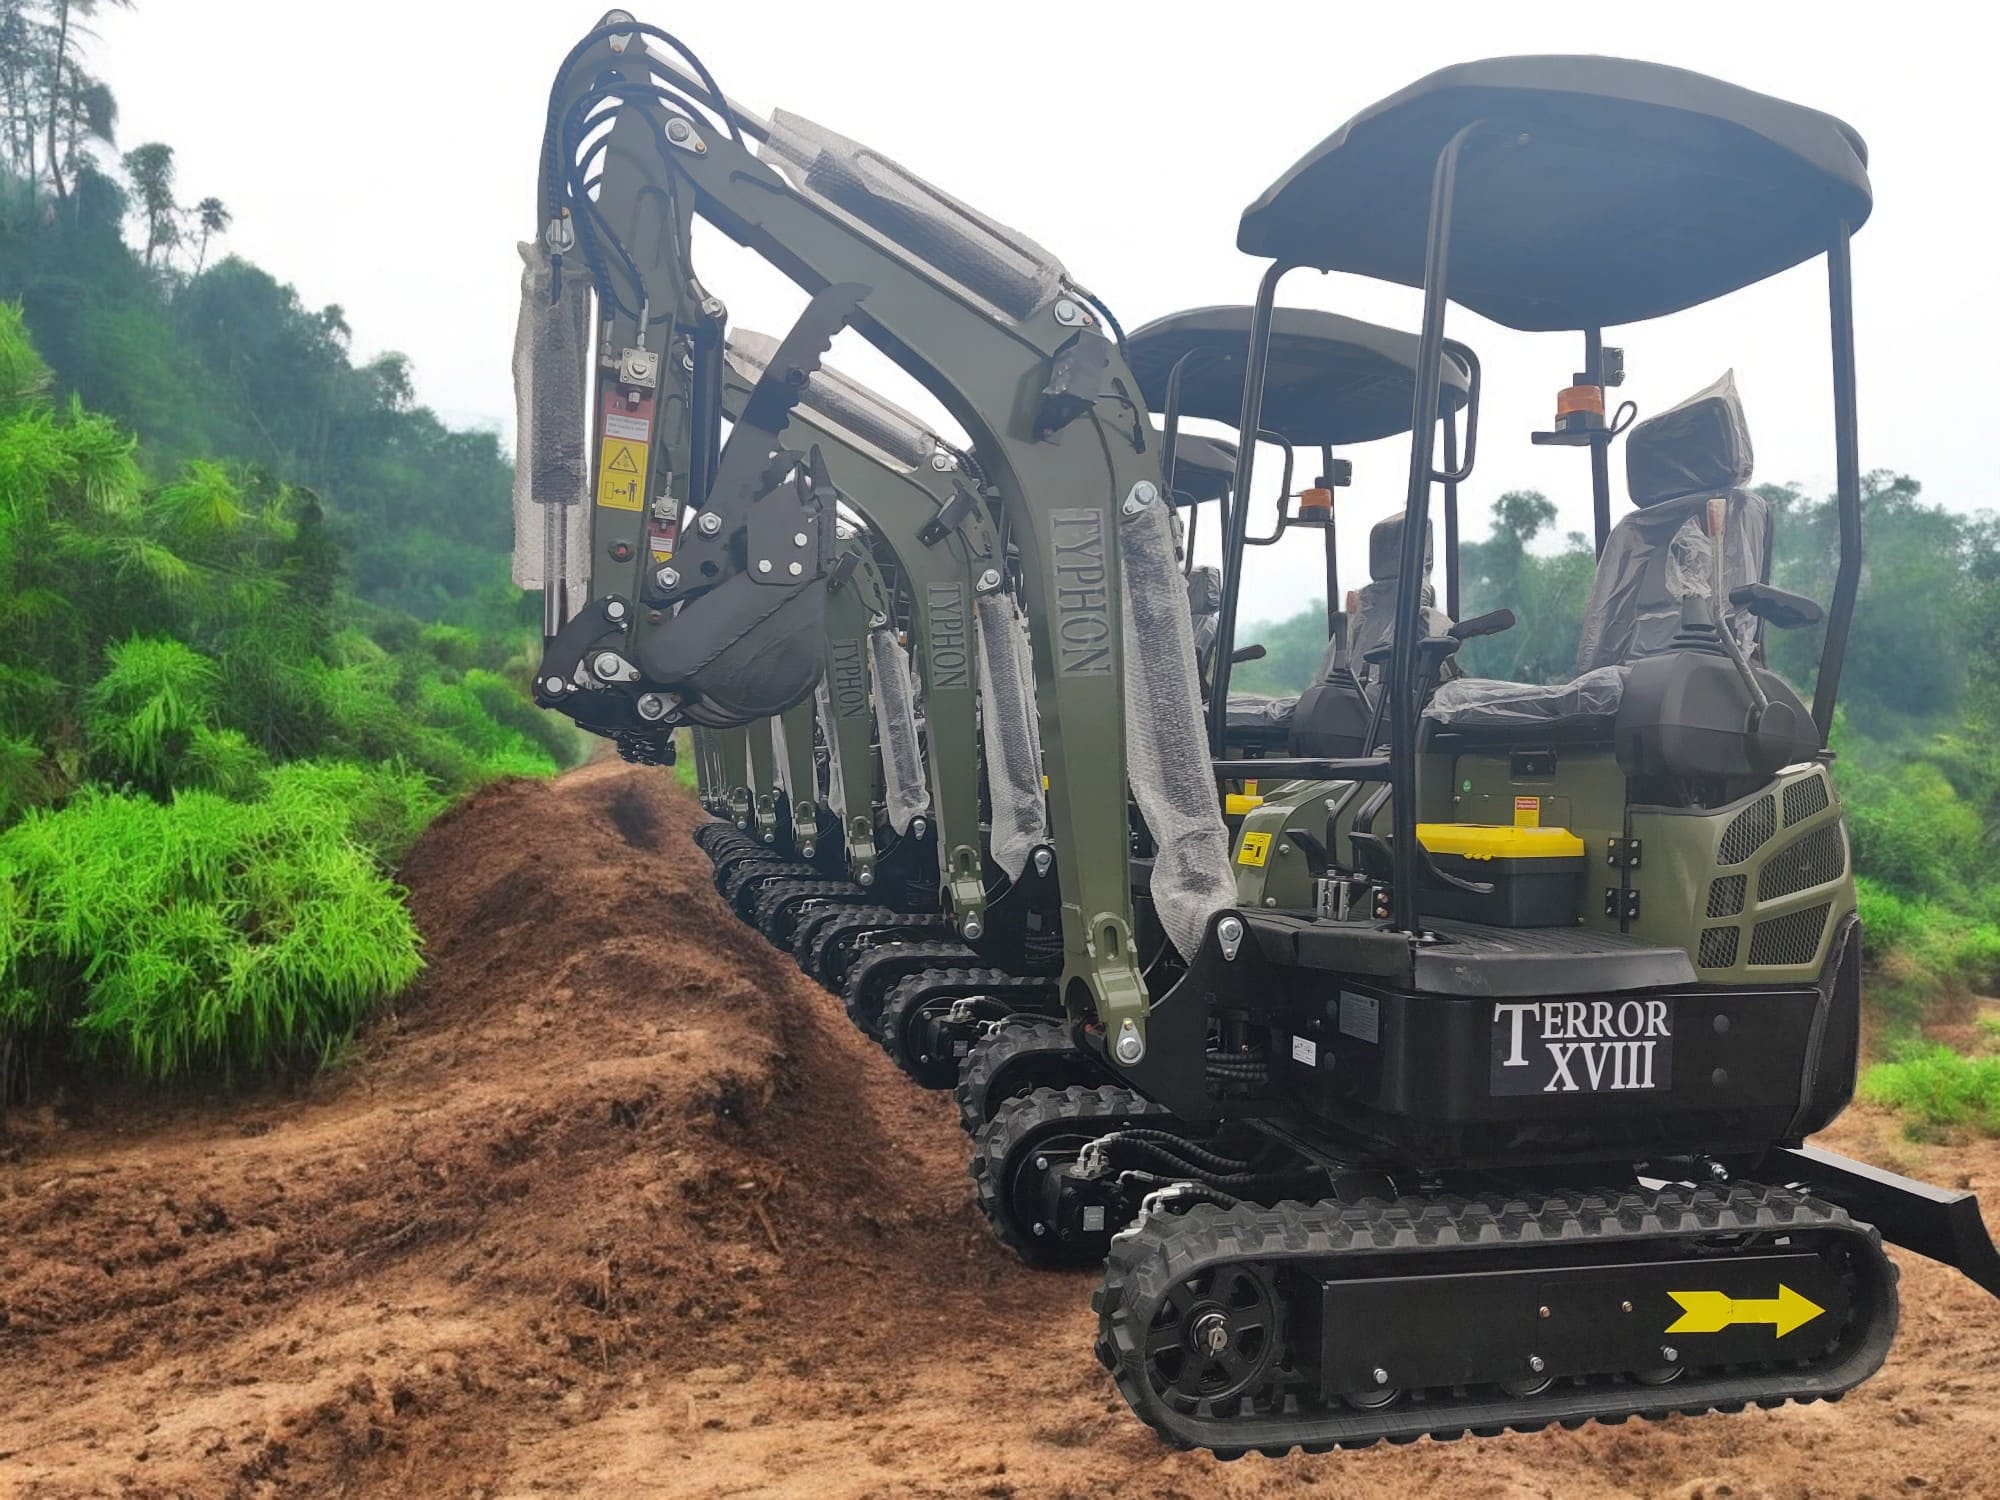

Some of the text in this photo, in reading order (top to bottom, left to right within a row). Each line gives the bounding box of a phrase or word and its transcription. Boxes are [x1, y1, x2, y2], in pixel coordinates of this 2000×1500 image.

[1053, 511, 1111, 673] TYPHON
[929, 583, 967, 688] TYPHON
[833, 639, 865, 718] TYPHON
[1493, 1001, 1671, 1066] TERROR
[1544, 1041, 1656, 1091] XVIII
